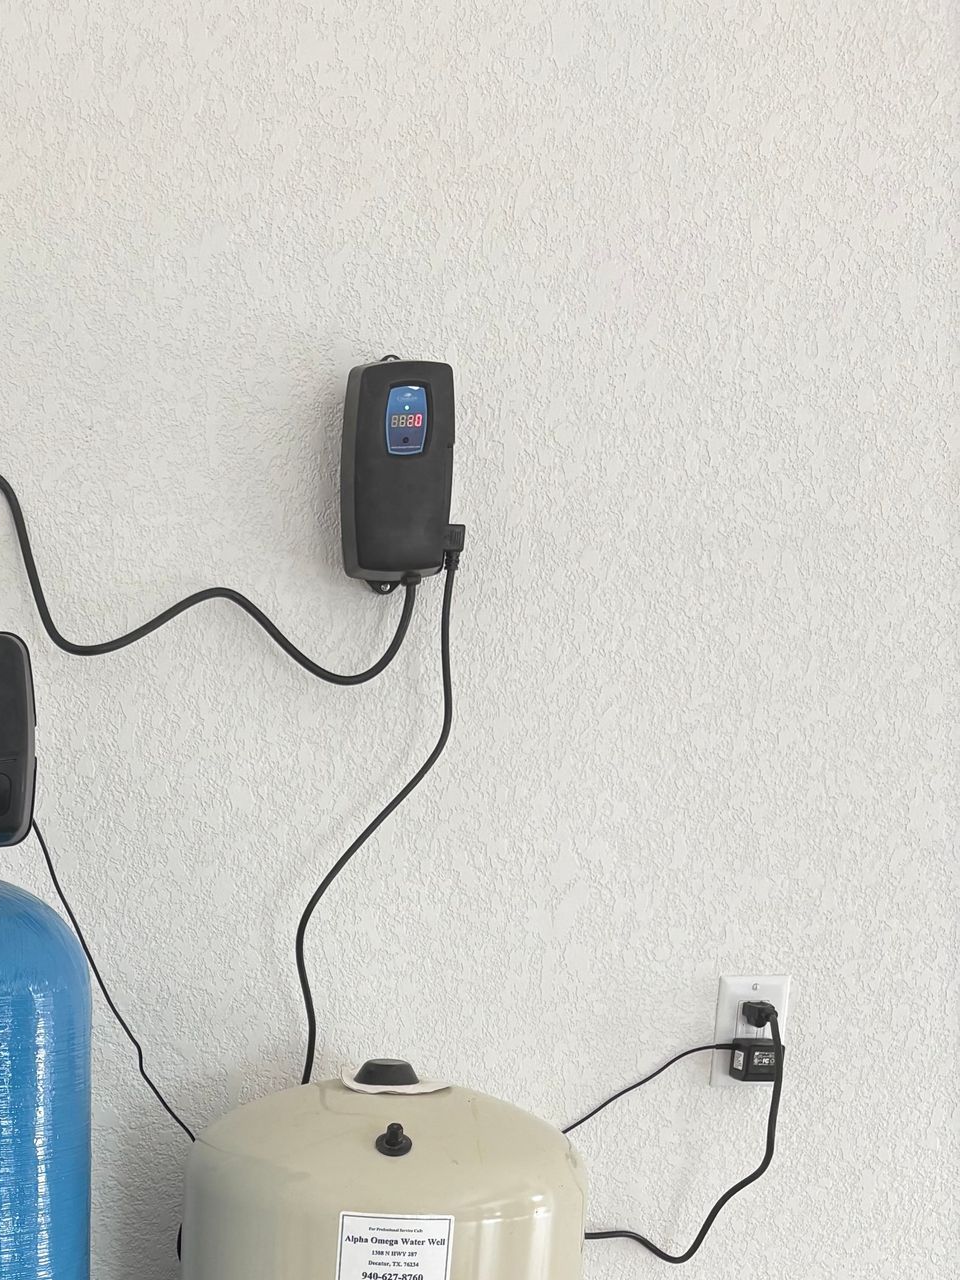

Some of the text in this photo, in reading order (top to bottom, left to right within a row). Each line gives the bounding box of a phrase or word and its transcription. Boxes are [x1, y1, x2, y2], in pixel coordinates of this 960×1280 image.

[345, 1235, 446, 1246] Alpha Omega Water Well
